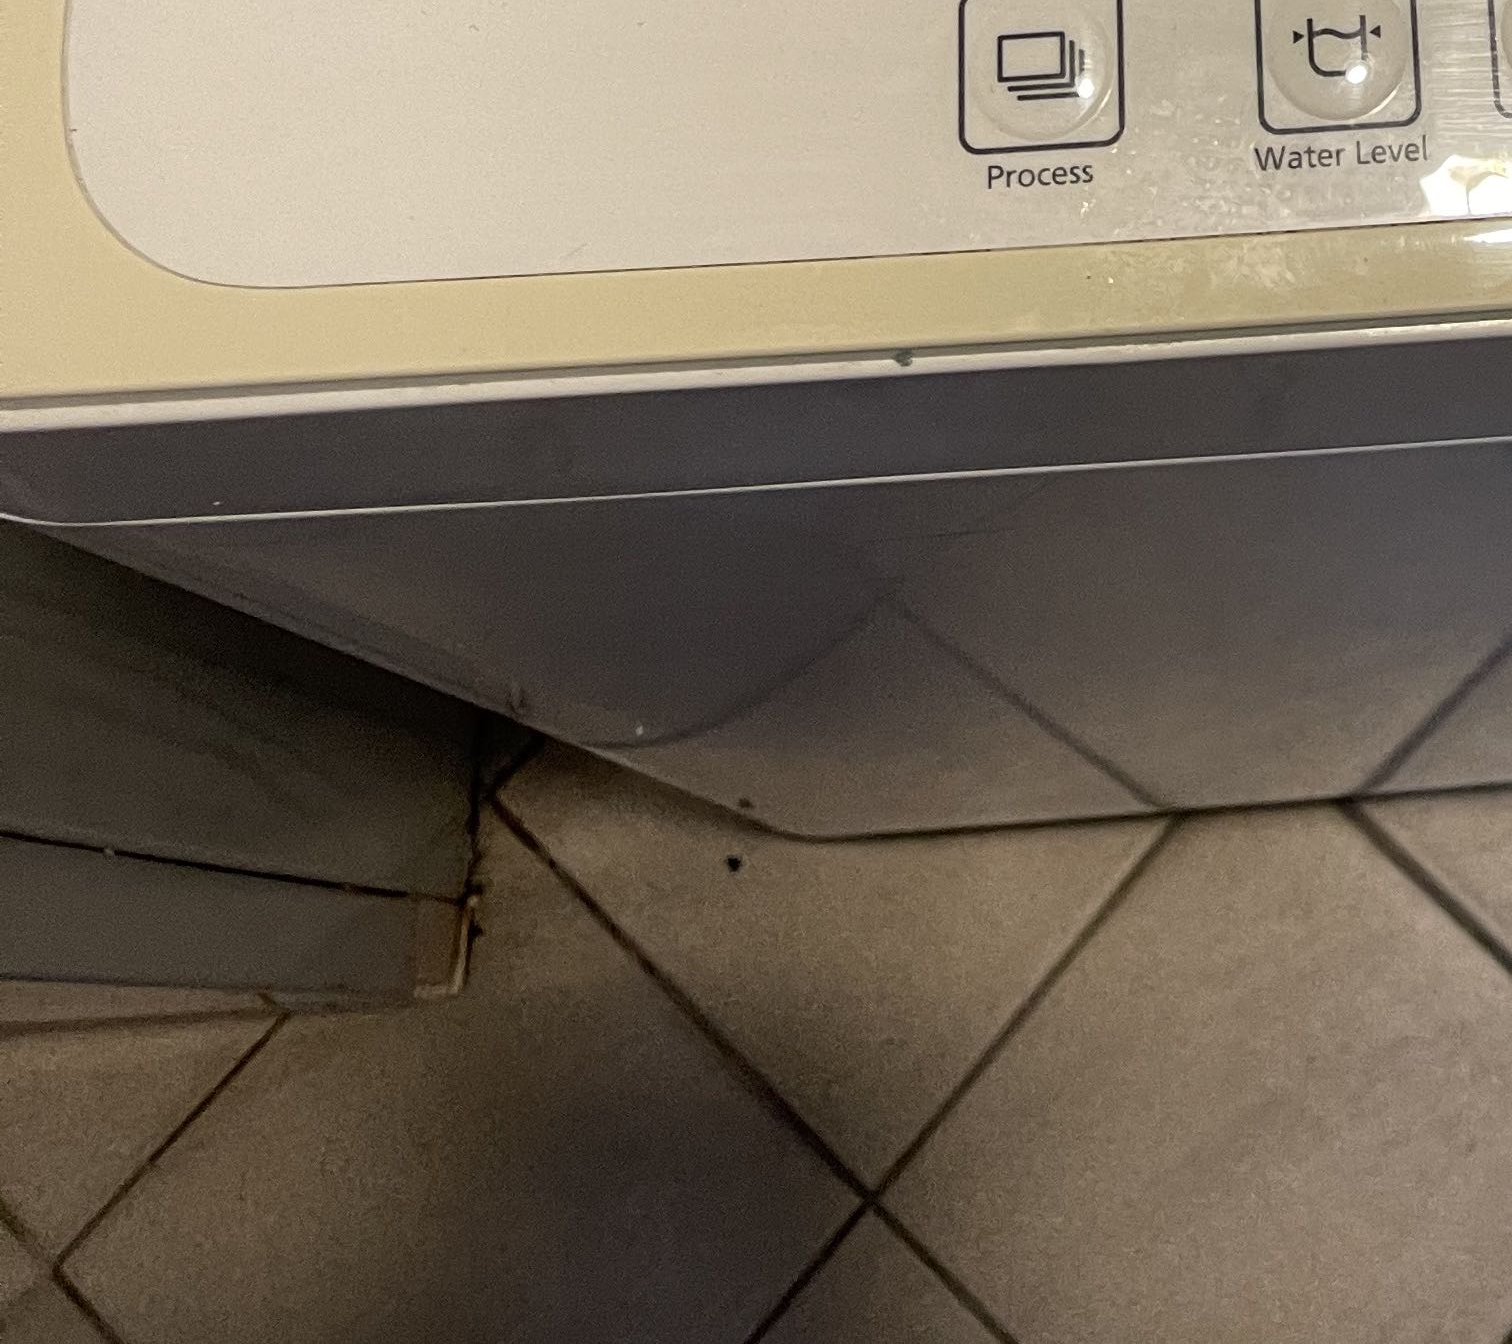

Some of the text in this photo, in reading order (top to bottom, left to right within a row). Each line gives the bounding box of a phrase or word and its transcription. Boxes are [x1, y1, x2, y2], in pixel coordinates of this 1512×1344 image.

[1254, 135, 1429, 172] Water Level
[987, 160, 1094, 188] Process
